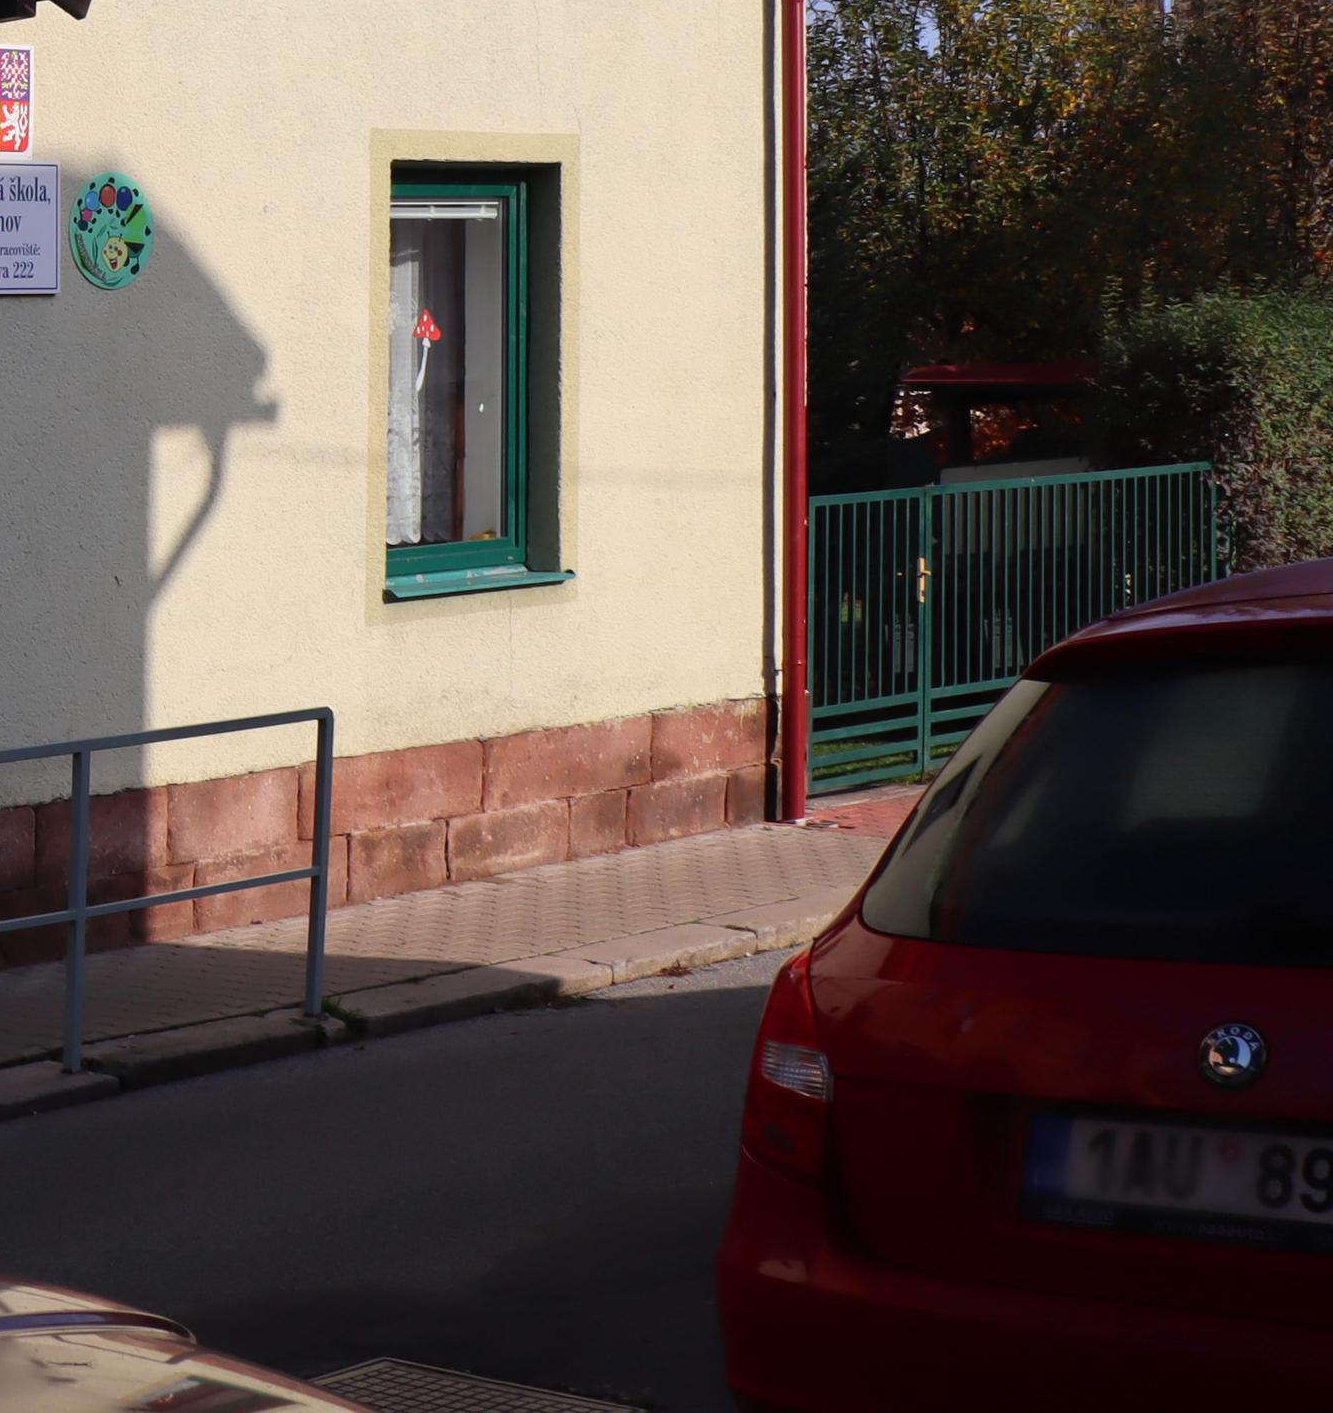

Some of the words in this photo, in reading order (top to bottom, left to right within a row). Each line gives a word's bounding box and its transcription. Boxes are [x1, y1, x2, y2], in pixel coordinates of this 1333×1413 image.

[9, 176, 51, 204] škola,
[13, 261, 34, 279] 222
[1256, 1144, 1333, 1214] 89
